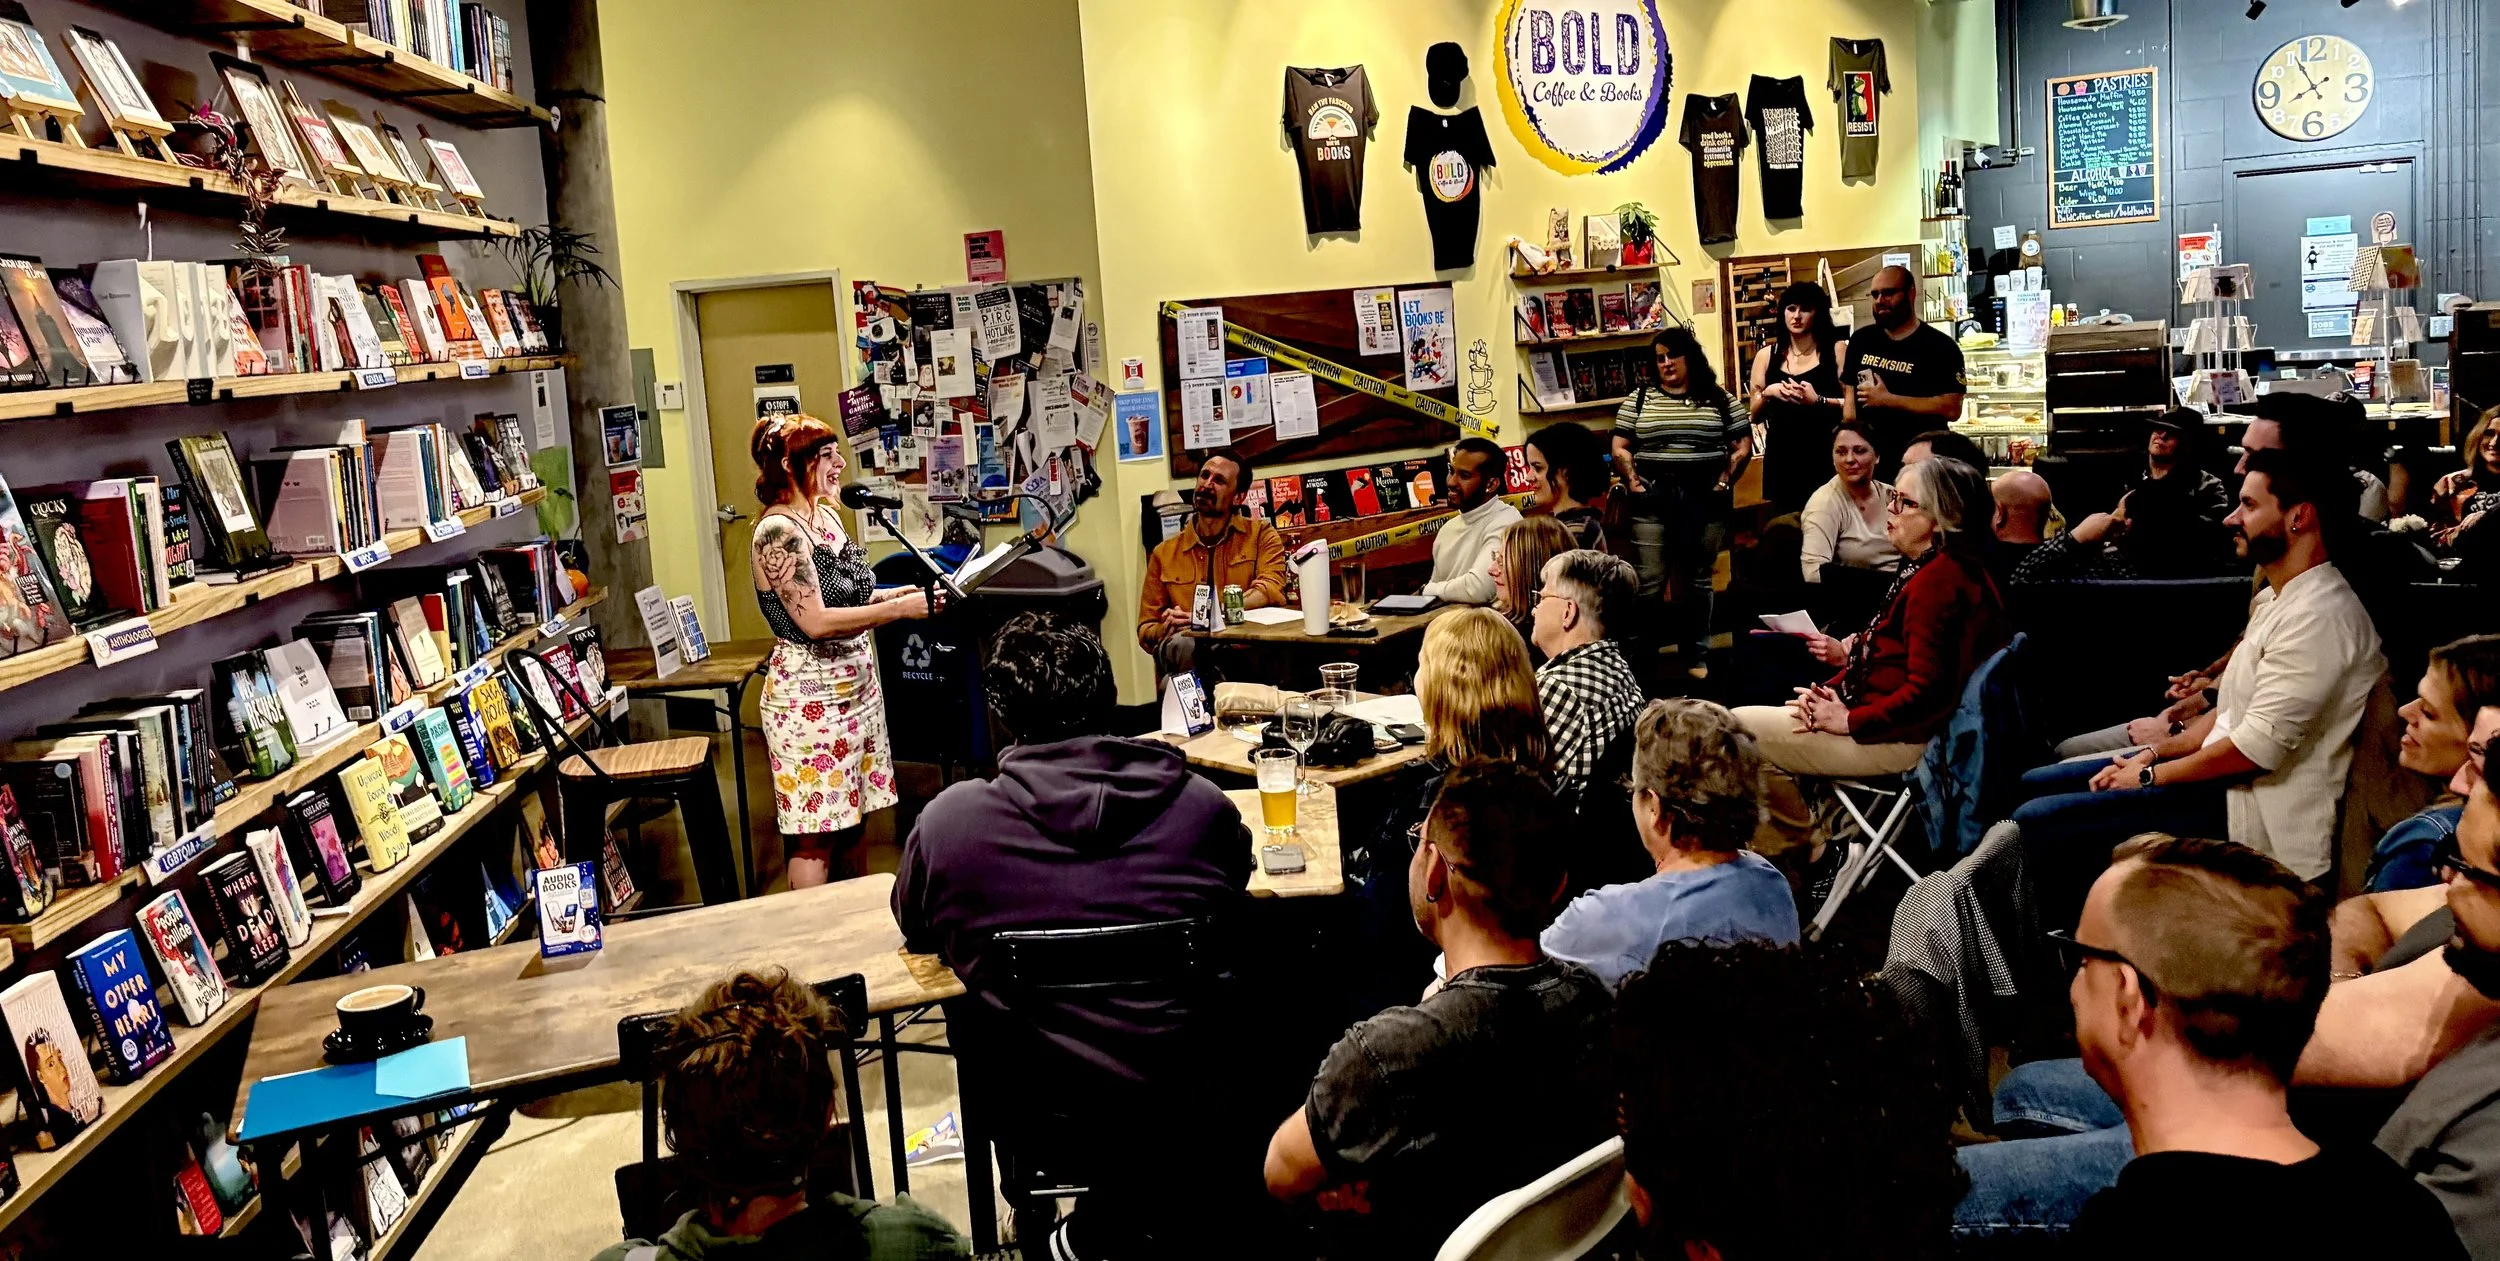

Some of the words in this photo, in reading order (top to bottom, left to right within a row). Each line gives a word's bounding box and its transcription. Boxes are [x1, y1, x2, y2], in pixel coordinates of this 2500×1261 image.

[1530, 9, 1641, 76] BOLD
[2298, 36, 2327, 62] 12
[2093, 73, 2148, 93] PASTRIES
[2344, 73, 2369, 103] 3
[1533, 81, 1576, 107] Coffee
[1580, 81, 1596, 101] &
[1600, 81, 1643, 102] Books
[2258, 80, 2281, 110] 9
[1848, 121, 1873, 132] RESIST
[2058, 114, 2082, 122] Coffee
[2302, 111, 2325, 137] 6
[1700, 139, 1716, 147] drink
[1717, 138, 1735, 146] coffee
[1715, 131, 1732, 139] books
[1317, 146, 1351, 161] BOOKS
[1437, 162, 1463, 179] BOLD
[1703, 160, 1734, 168] oppression
[2071, 167, 2114, 182] ALCOHOL
[2058, 183, 2078, 192] Beer
[2079, 189, 2097, 197] Wine
[2059, 196, 2079, 207] Cider
[1403, 300, 1420, 314] LET
[1405, 312, 1433, 327] BOOKS
[1435, 311, 1445, 324] BE
[985, 324, 1015, 340] HOTLINE
[1242, 332, 1278, 356] CAUTION
[1306, 357, 1341, 381] CAUTION
[1861, 353, 1914, 374] BREAKSIDE
[1353, 374, 1387, 397] CAUTION
[1415, 393, 1446, 418] CAUTION
[1455, 410, 1482, 432] CAUTION
[1505, 449, 1525, 468] 19
[1306, 481, 1328, 489] ATWOOD
[30, 499, 67, 517] CLOCKS
[1355, 532, 1388, 552] CAUTION
[110, 628, 152, 647] ANTHOLOGIES
[902, 671, 933, 680] RECYCLE
[244, 692, 286, 732] REFUSE
[456, 716, 468, 736] THE
[464, 736, 481, 762] TAKE
[163, 839, 201, 872] LGBTQIA+
[223, 871, 258, 898] WHERE
[542, 881, 577, 893] BOOKS
[543, 872, 575, 885] AUDIO
[153, 906, 184, 933] People
[237, 908, 274, 942] DEAD
[162, 923, 192, 950] Collide
[250, 932, 279, 960] SLEEP
[102, 950, 127, 977] MY
[105, 974, 148, 1009] OTHER
[114, 999, 157, 1038] HEART
